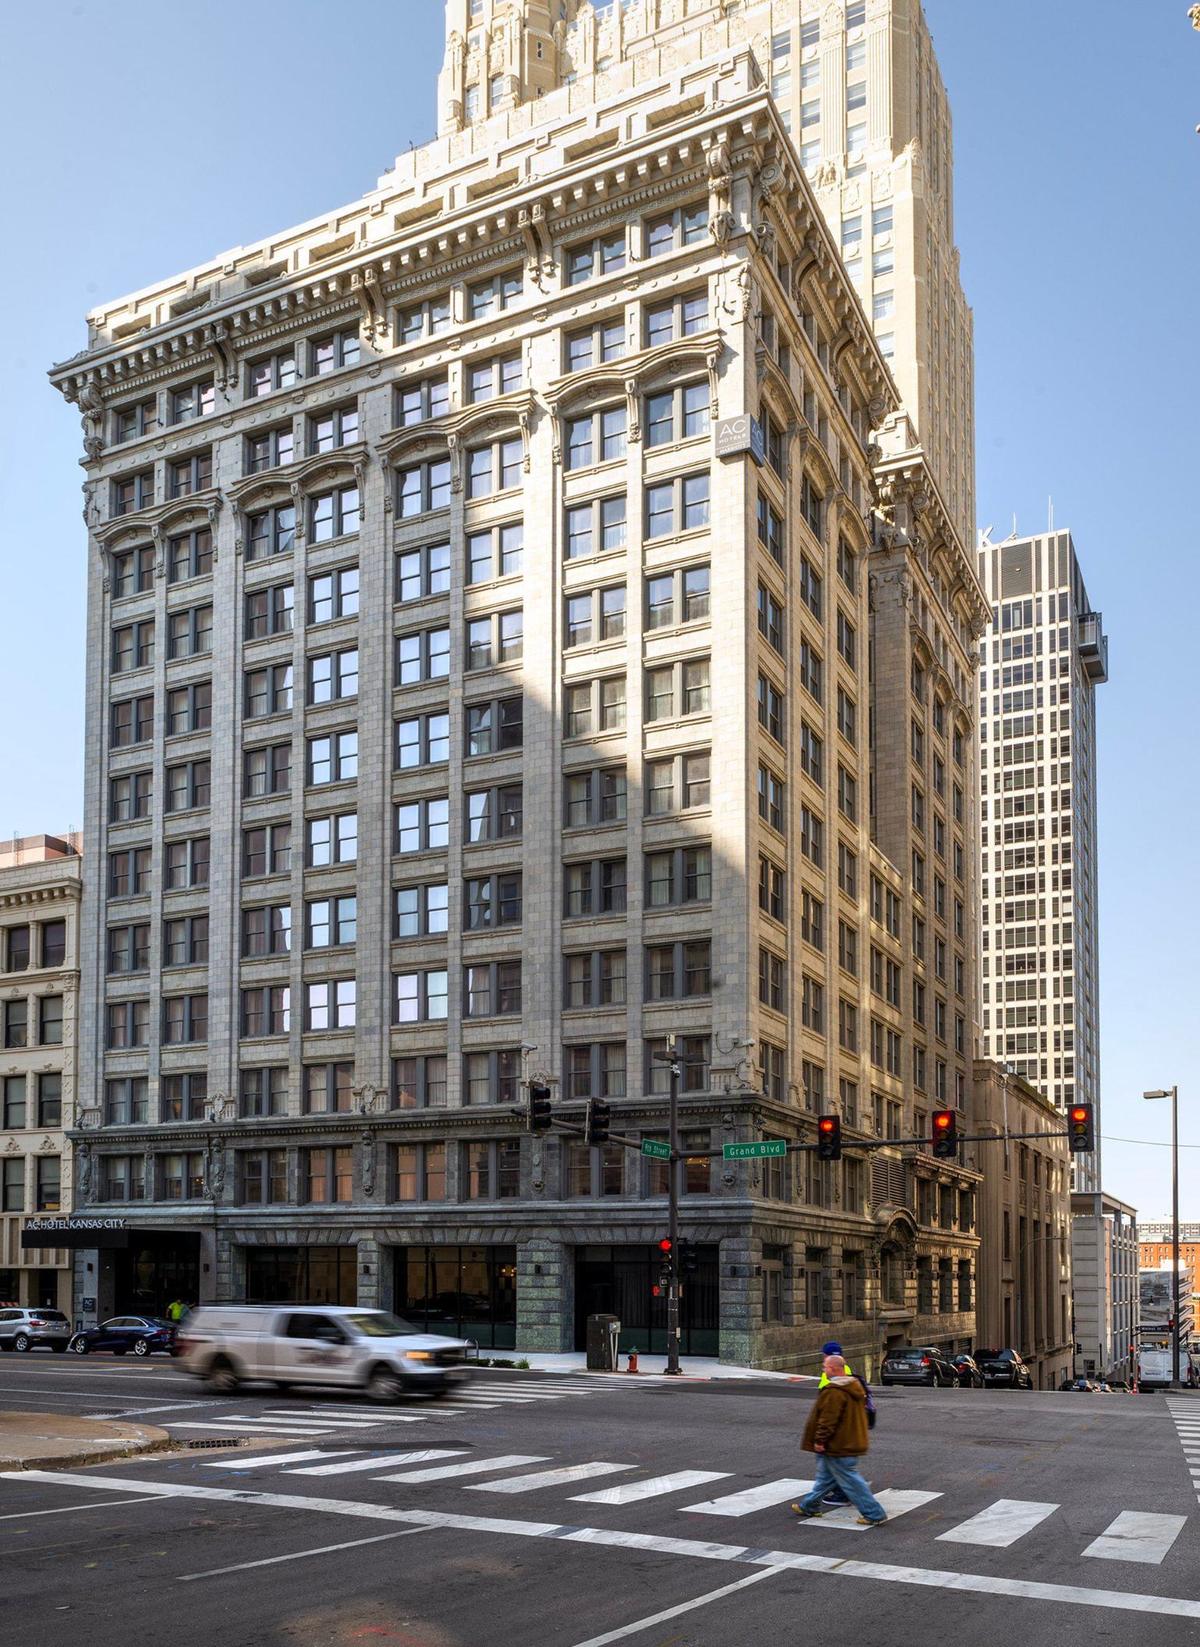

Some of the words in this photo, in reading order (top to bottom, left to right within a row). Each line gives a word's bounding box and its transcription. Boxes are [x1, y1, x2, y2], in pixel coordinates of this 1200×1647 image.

[719, 419, 746, 438] AC
[729, 1146, 755, 1156] Grand
[760, 1145, 780, 1154] Blvd
[26, 1220, 39, 1229] AC
[41, 1219, 69, 1229] HOTEL
[69, 1219, 102, 1229] KANSAS
[104, 1218, 125, 1228] CITY
